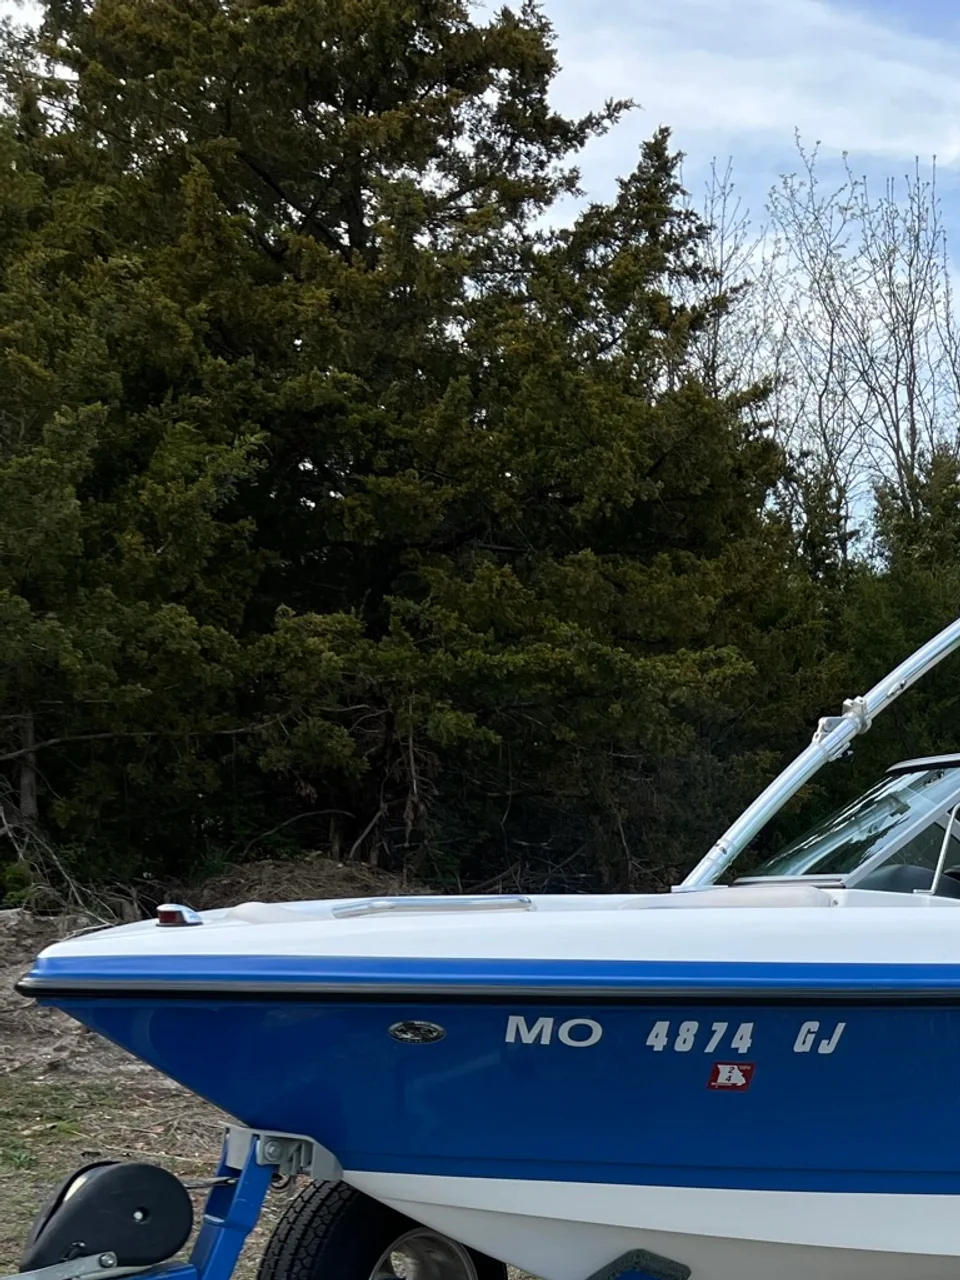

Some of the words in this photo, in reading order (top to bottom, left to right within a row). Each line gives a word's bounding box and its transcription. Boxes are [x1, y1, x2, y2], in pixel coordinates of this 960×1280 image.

[505, 1015, 603, 1047] MO
[646, 1020, 754, 1053] 4874
[793, 1021, 846, 1054] GJ
